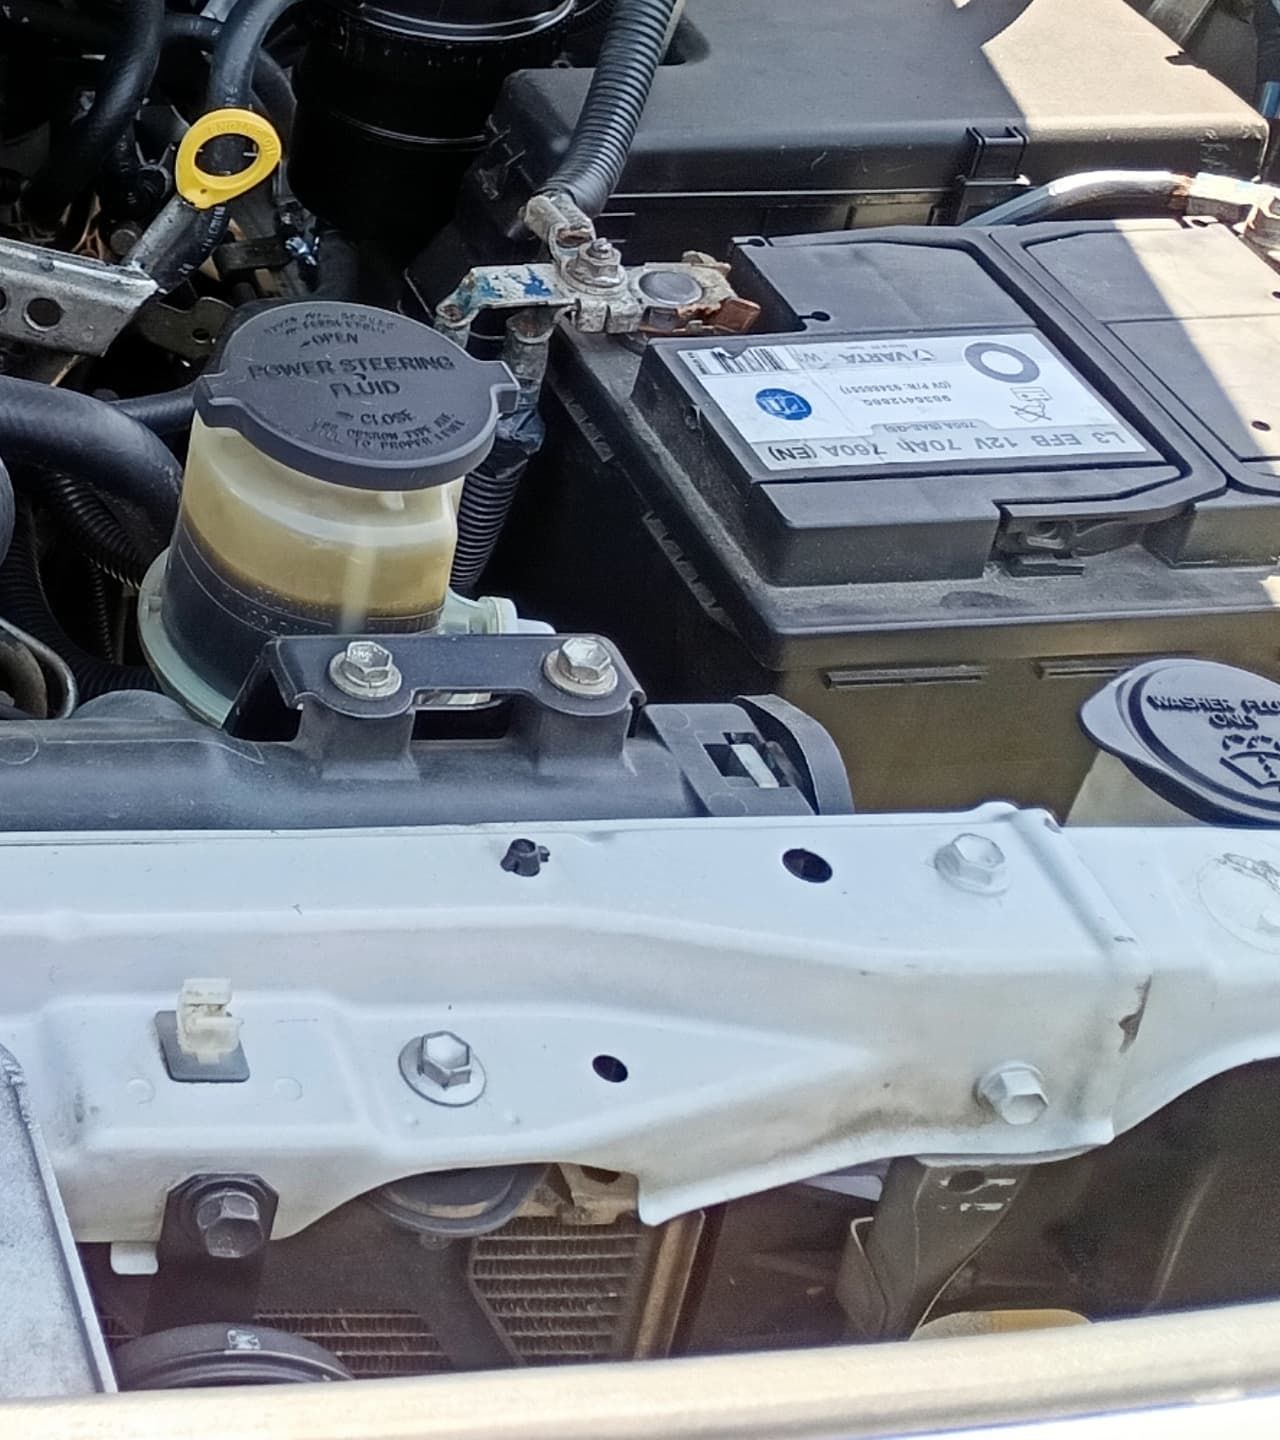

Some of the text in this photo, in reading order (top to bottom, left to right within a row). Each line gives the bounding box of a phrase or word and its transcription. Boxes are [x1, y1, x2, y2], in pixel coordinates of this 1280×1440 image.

[312, 333, 359, 345] OPEN
[837, 351, 913, 365] VARTA
[248, 355, 456, 380] POWER STEERING
[329, 379, 401, 399] FLUID
[359, 408, 417, 426] CLOSE
[379, 436, 434, 450] PROPER
[767, 430, 1126, 461] L3 EFB 12V 70Ah 760A (EN)
[1146, 695, 1236, 712] WASHER
[1208, 713, 1259, 730] ONLY
